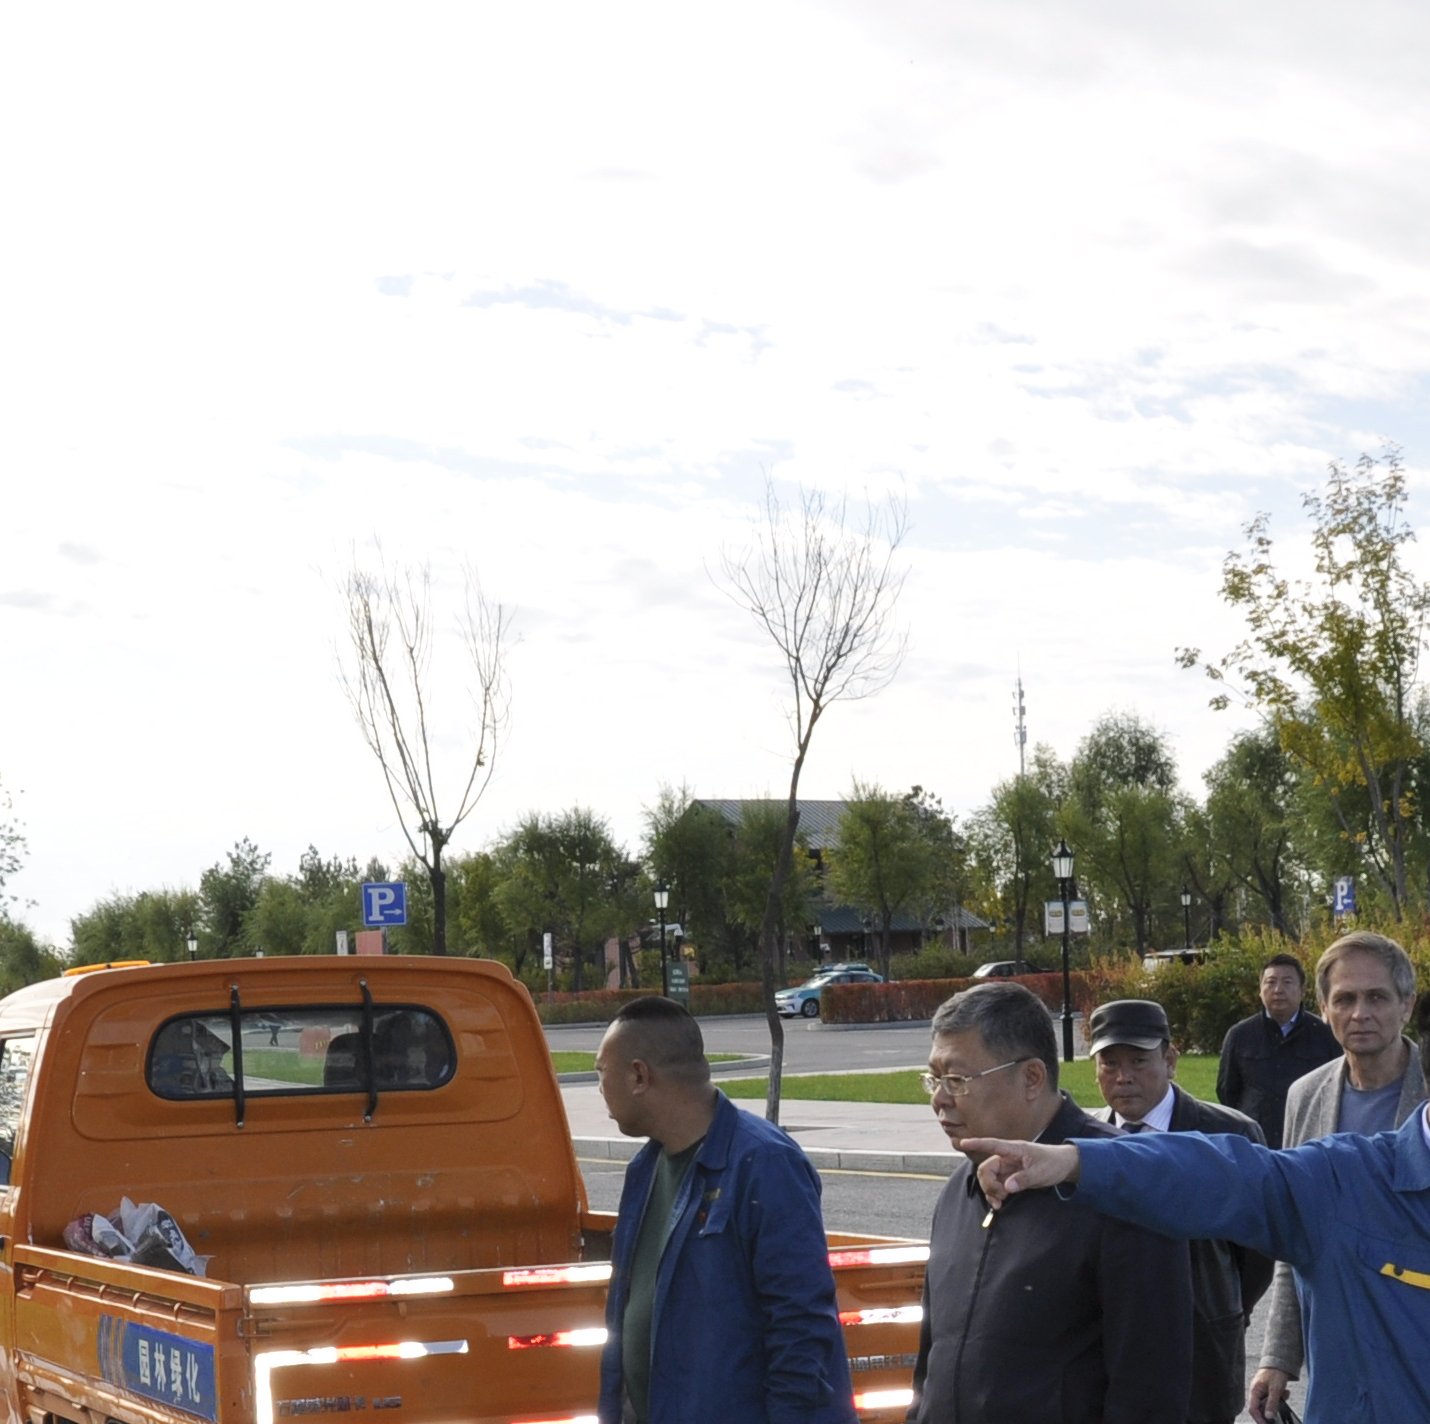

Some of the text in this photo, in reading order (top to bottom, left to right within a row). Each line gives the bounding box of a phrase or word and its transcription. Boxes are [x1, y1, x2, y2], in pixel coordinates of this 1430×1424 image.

[367, 887, 395, 921] P
[1335, 880, 1348, 910] P
[138, 1338, 202, 1404] 园林绿化
